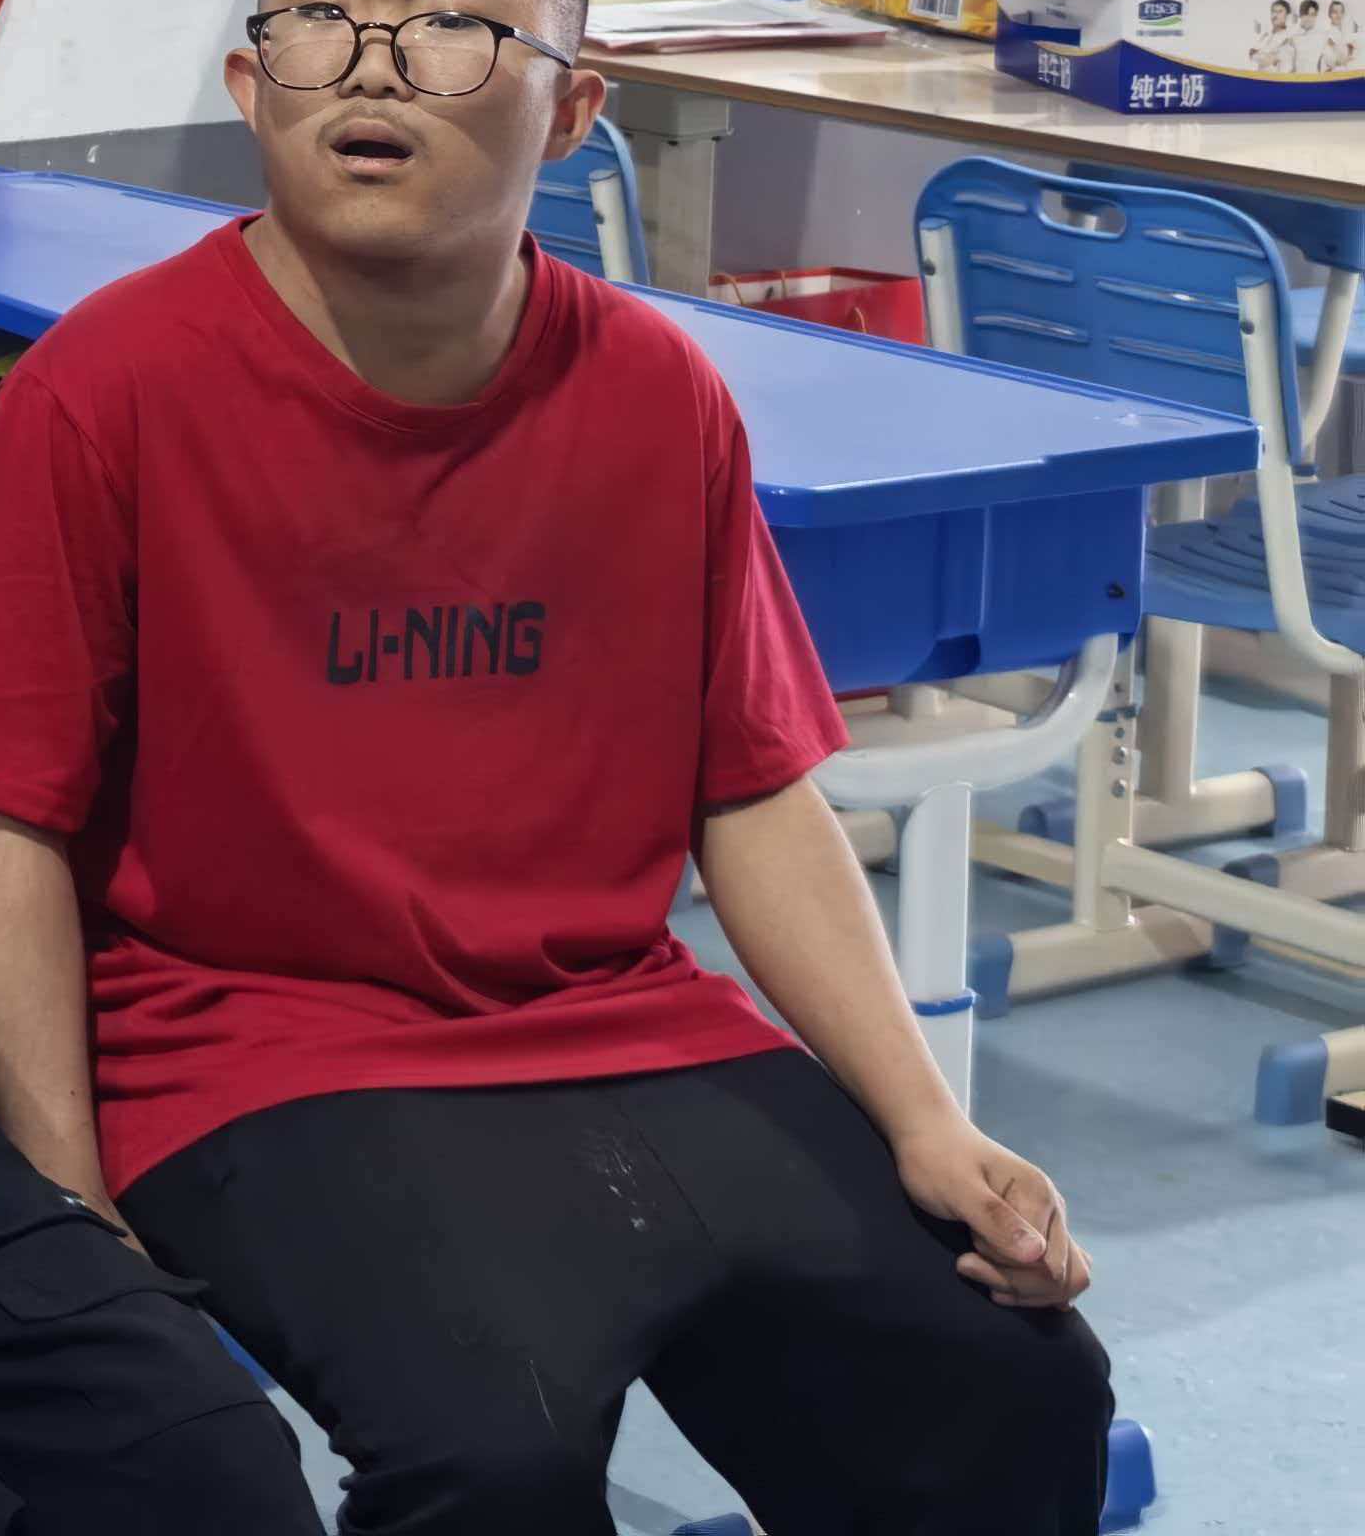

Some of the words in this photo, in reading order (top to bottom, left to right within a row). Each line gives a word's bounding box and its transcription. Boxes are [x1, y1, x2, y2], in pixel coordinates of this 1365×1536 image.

[1129, 73, 1206, 109] 纯牛奶
[325, 600, 547, 686] LI-NING
